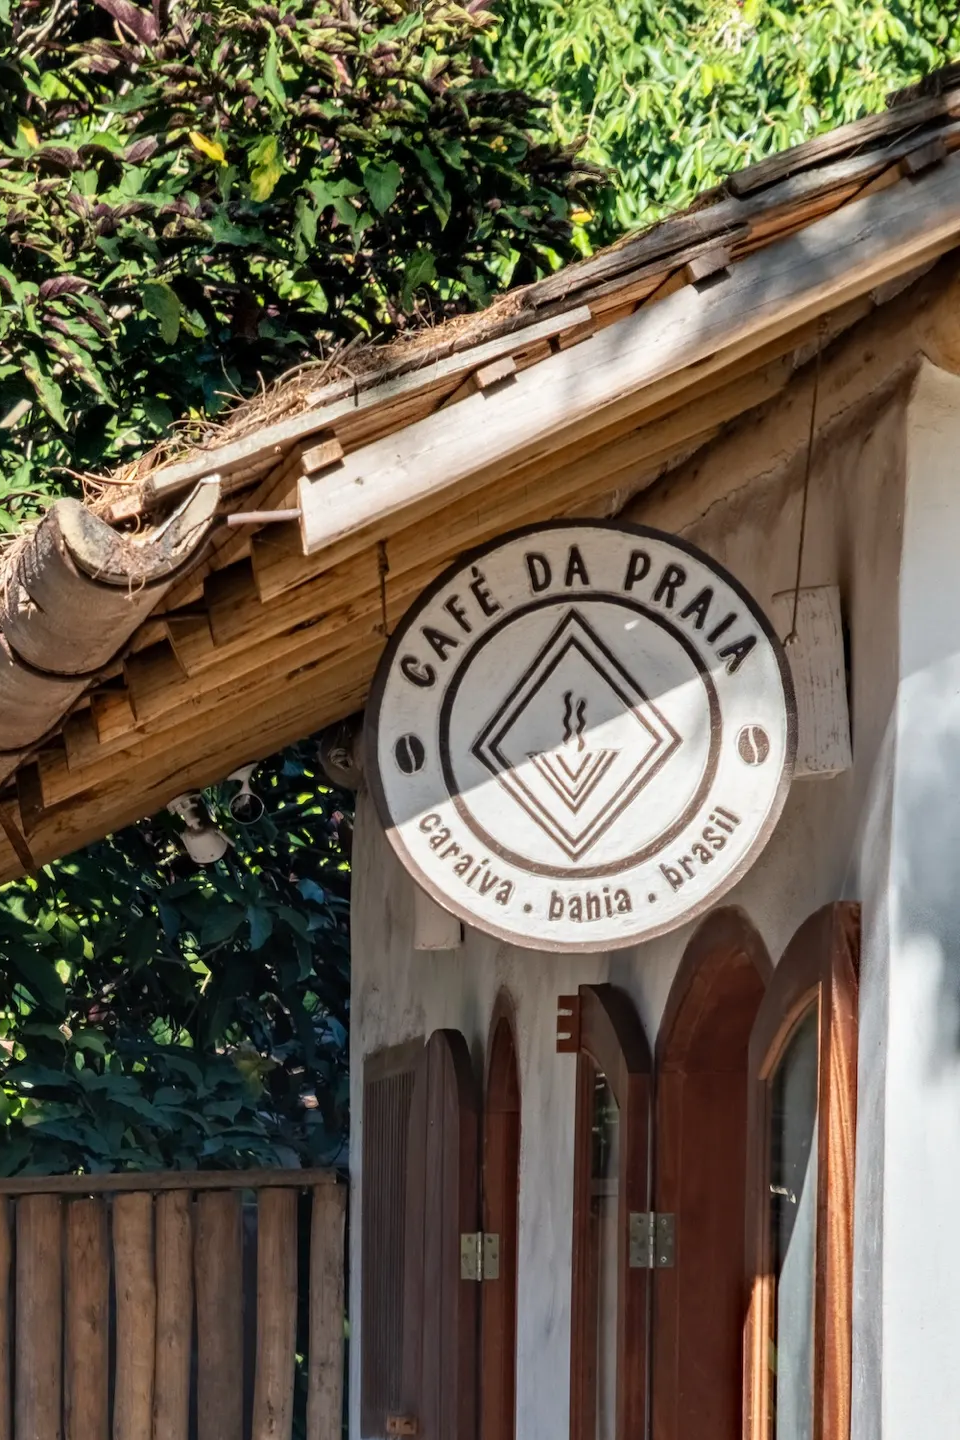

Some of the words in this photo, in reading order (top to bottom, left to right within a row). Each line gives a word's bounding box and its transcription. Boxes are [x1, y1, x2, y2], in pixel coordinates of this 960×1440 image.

[401, 566, 500, 688] CAFÉ
[526, 545, 589, 592] DA
[624, 549, 757, 673] PRAIA
[548, 886, 633, 922] bahia
[659, 806, 741, 892] brasil
